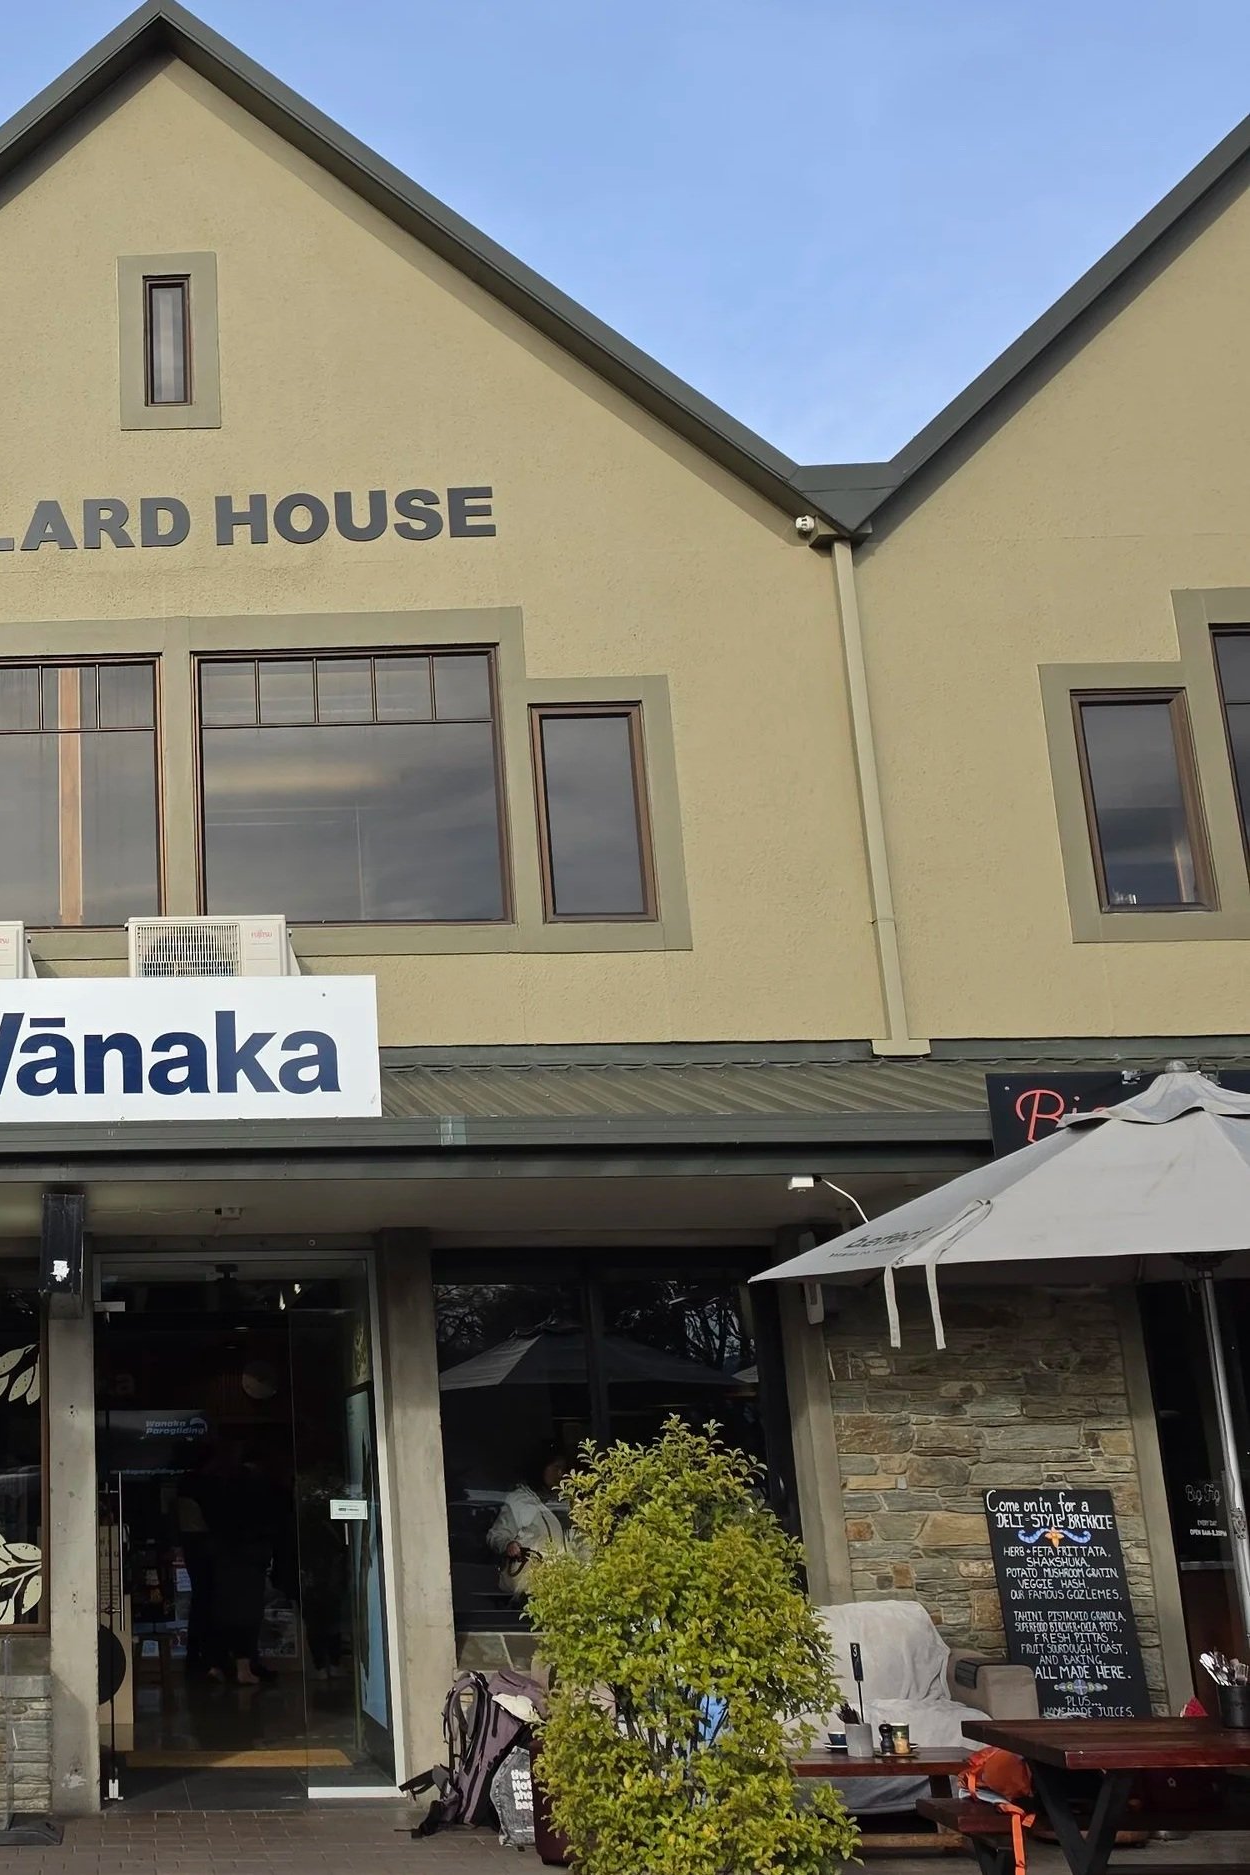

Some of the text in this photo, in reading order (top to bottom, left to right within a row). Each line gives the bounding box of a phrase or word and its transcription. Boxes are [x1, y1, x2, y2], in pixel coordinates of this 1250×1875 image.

[215, 486, 498, 545] HOUSE
[986, 1489, 1020, 1513] Come
[1058, 1491, 1077, 1521] for
[1081, 1501, 1089, 1513] a
[1067, 1514, 1114, 1530] BREKKIE
[1003, 1545, 1025, 1557] HERB
[1032, 1545, 1054, 1557] FETA
[1006, 1567, 1038, 1578] POTATO
[1043, 1567, 1085, 1579] MUSHROOM
[1017, 1578, 1054, 1590] VEGGIE
[1010, 1589, 1025, 1600] OUR
[1028, 1589, 1065, 1600] FAMOUS
[1013, 1610, 1044, 1622] TAHINI
[1047, 1610, 1089, 1622] PISTACHIO
[1014, 1621, 1048, 1633] SUPERFOOD
[1034, 1632, 1071, 1644] FRESH
[852, 1644, 858, 1657] 3
[1021, 1643, 1045, 1655] FRUIT
[1046, 1643, 1092, 1655] SOURDOUGH
[1039, 1655, 1059, 1665] AND
[1034, 1665, 1132, 1680] ALL MADE HERE.
